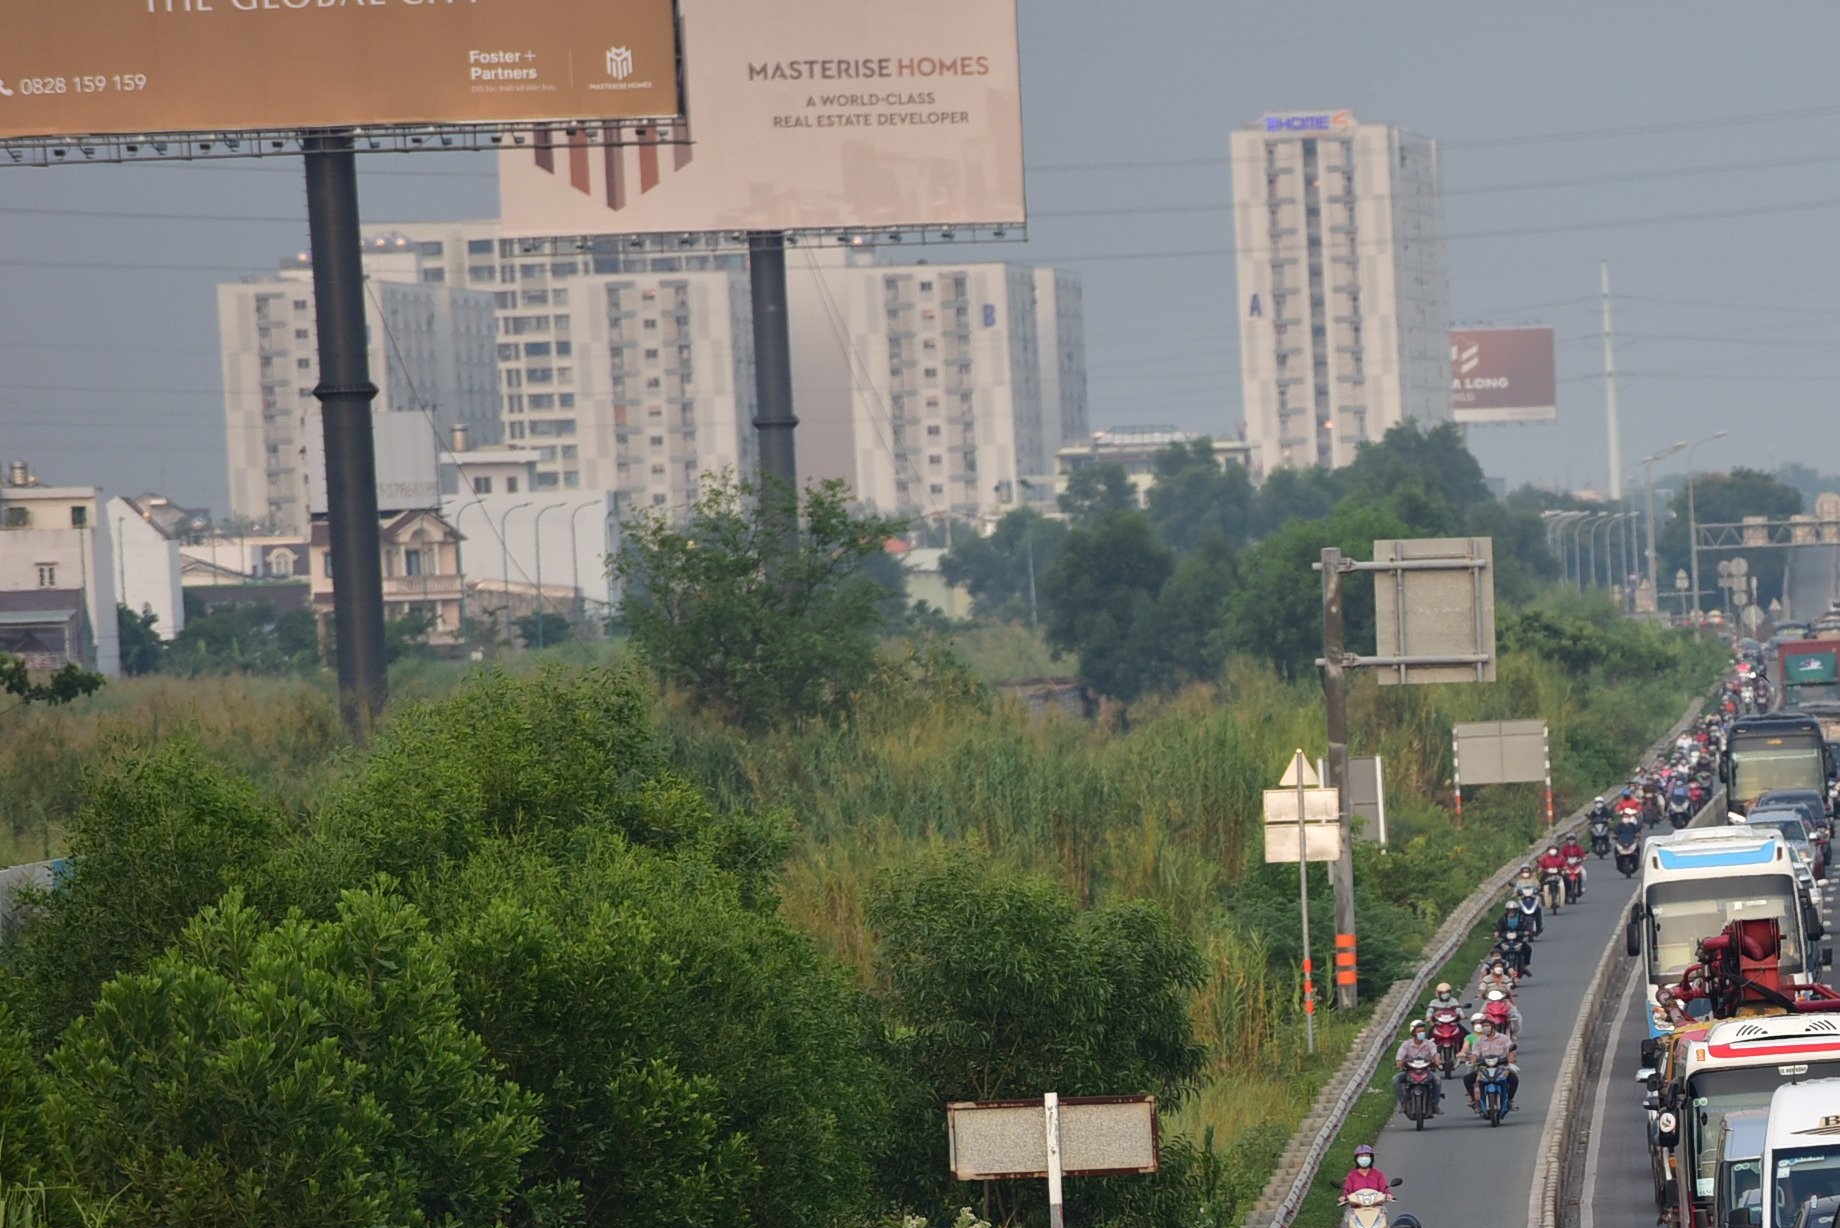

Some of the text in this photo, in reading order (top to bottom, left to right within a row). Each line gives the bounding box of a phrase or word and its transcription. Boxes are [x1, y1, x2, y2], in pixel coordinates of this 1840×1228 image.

[469, 50, 521, 64] Foster
[470, 67, 538, 80] Partners
[748, 55, 990, 82] MASTERISE HOMES
[20, 73, 148, 95] 0828 159 159
[806, 92, 936, 107] A WORLD-CLASS
[773, 111, 970, 128] REAL ESTATE DEVELOPER
[1463, 377, 1509, 389] LONG
